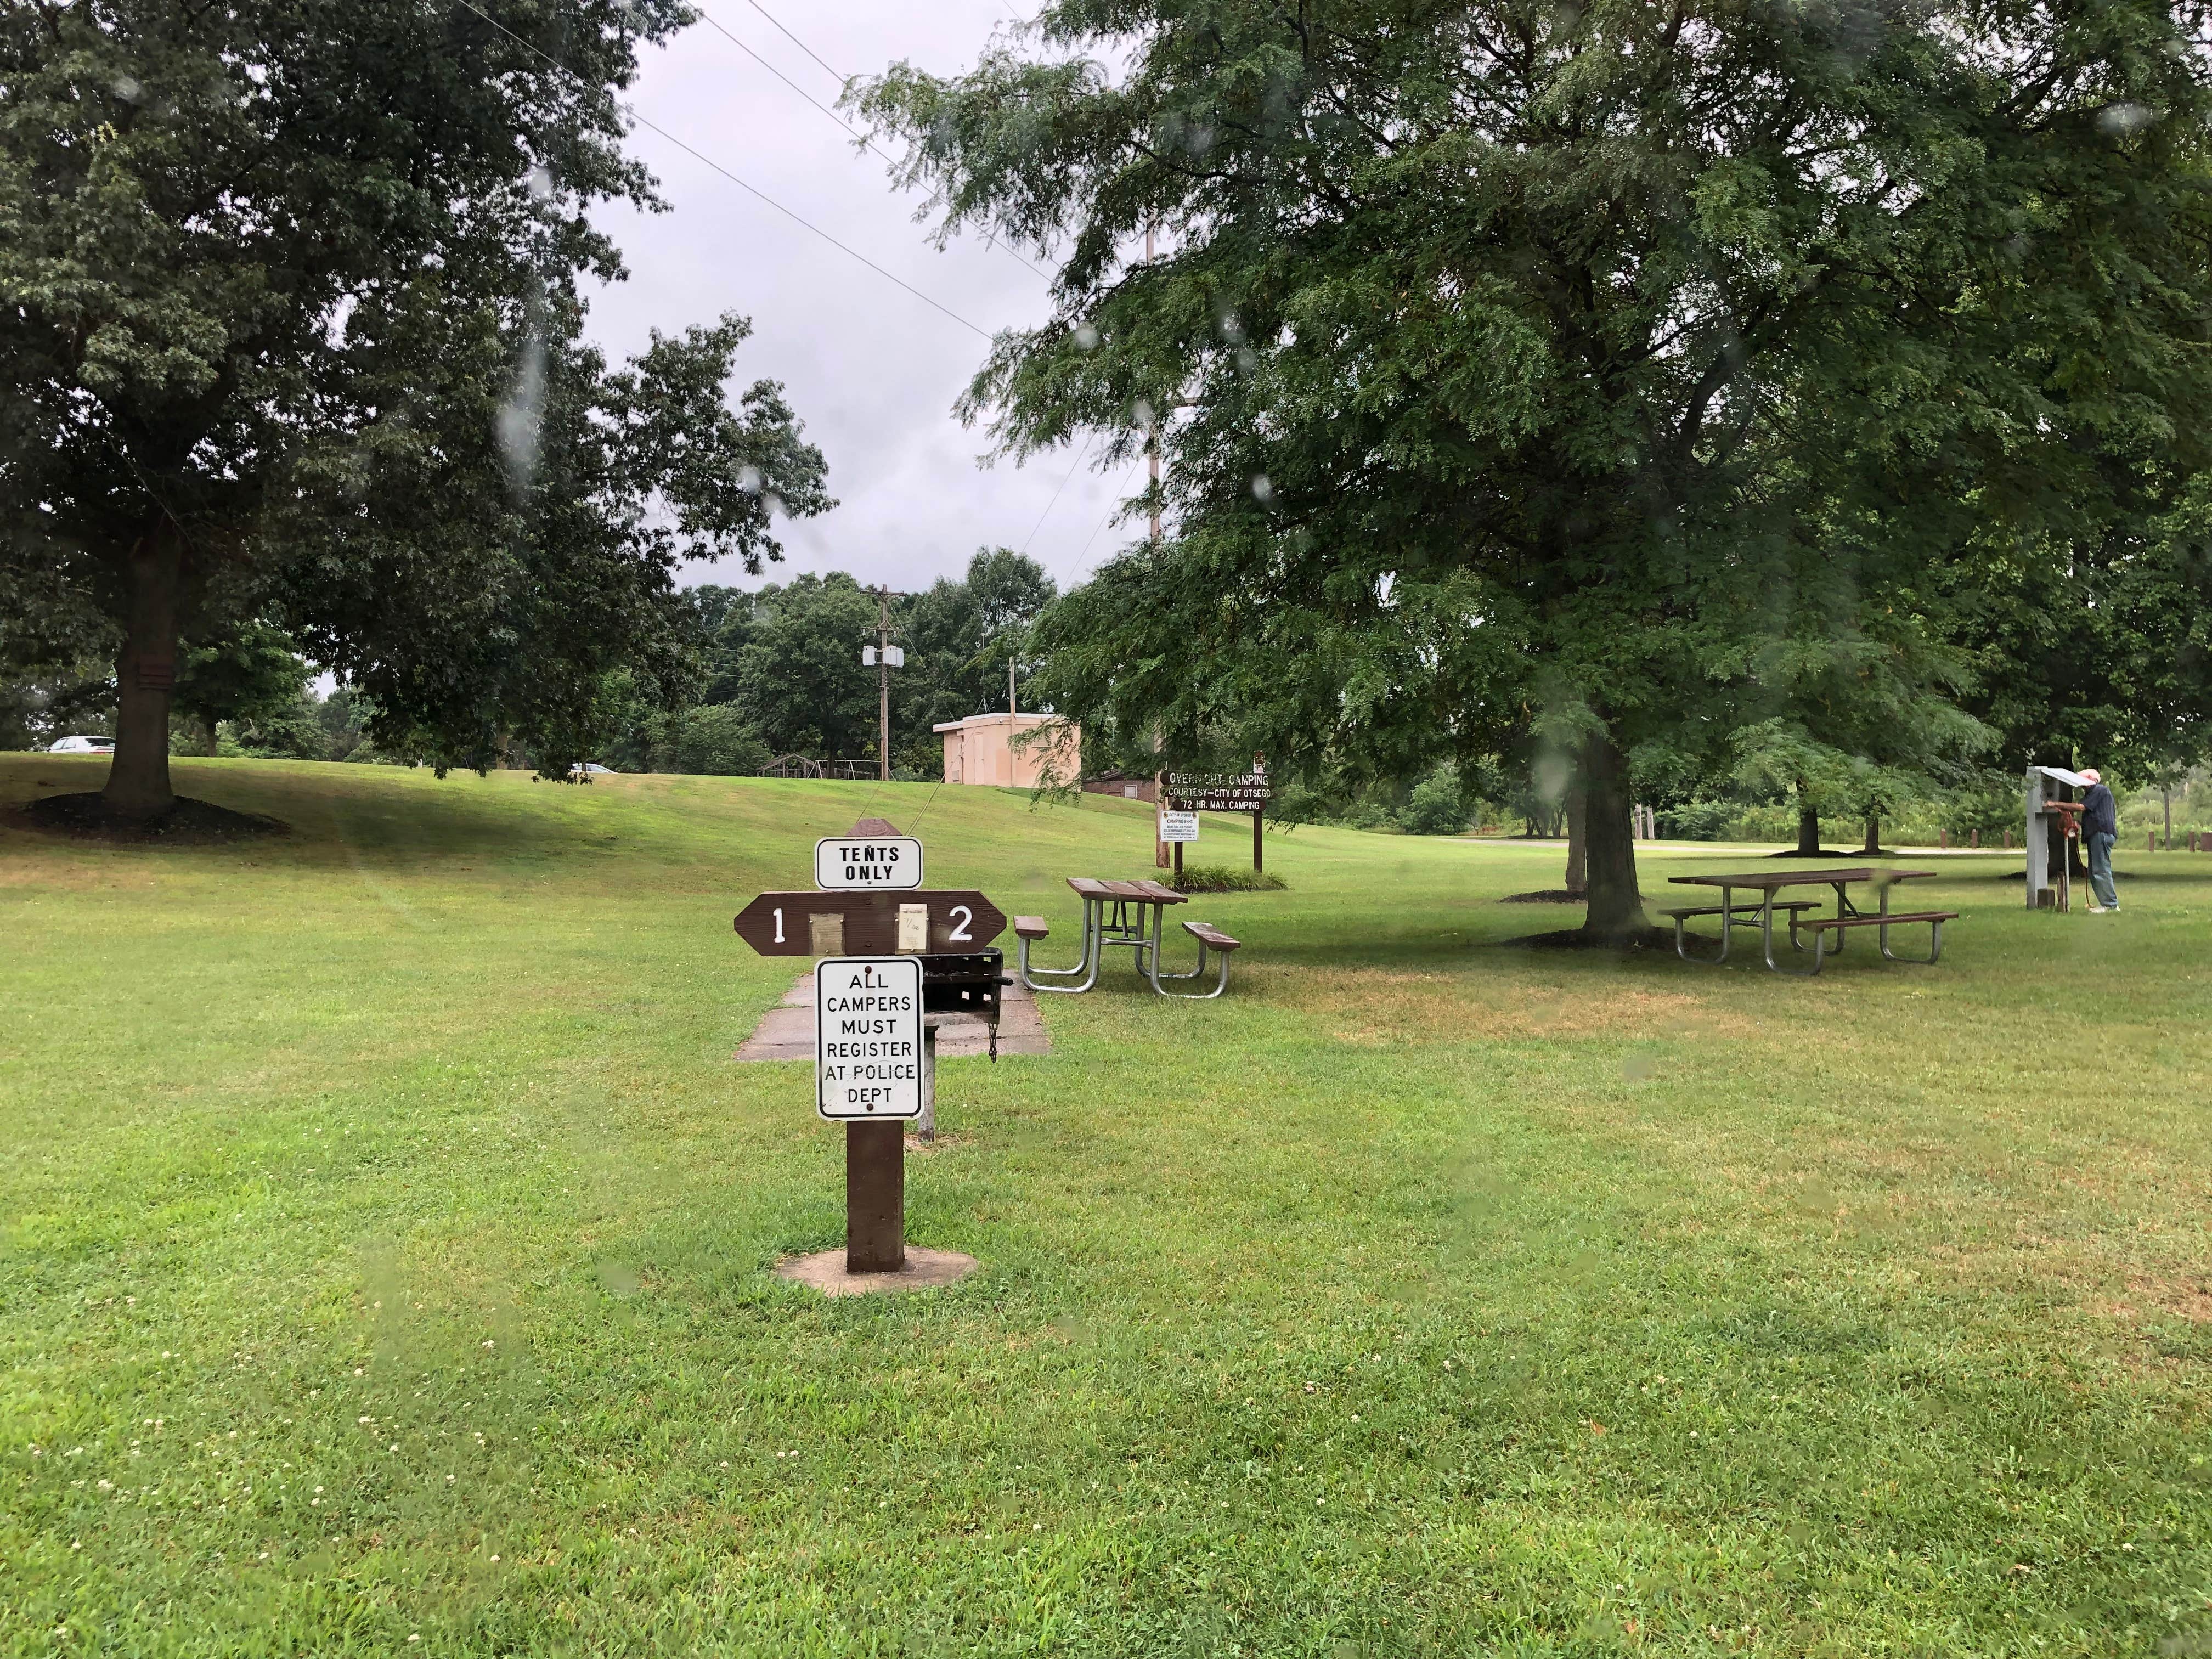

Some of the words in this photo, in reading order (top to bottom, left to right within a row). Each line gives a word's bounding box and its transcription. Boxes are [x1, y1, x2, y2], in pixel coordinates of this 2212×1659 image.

[1229, 774, 1269, 786] CAMPING
[1232, 789, 1242, 798] OF
[1244, 789, 1271, 798] OTSEGO
[1183, 800, 1192, 809] 72
[1196, 800, 1208, 809] HR.
[1210, 800, 1227, 809] MAX.
[1229, 800, 1260, 810] CAMPING
[839, 847, 899, 862] TENTS
[845, 865, 893, 881] ONLY
[773, 908, 785, 943] 1
[948, 905, 973, 941] 2
[849, 974, 889, 989] ALL
[827, 996, 911, 1012] CAMPERS
[842, 1019, 896, 1035] MUST
[827, 1042, 911, 1057] REGISTER
[825, 1065, 845, 1080] AT
[854, 1064, 915, 1080] POLICE
[848, 1088, 892, 1103] DEPT
